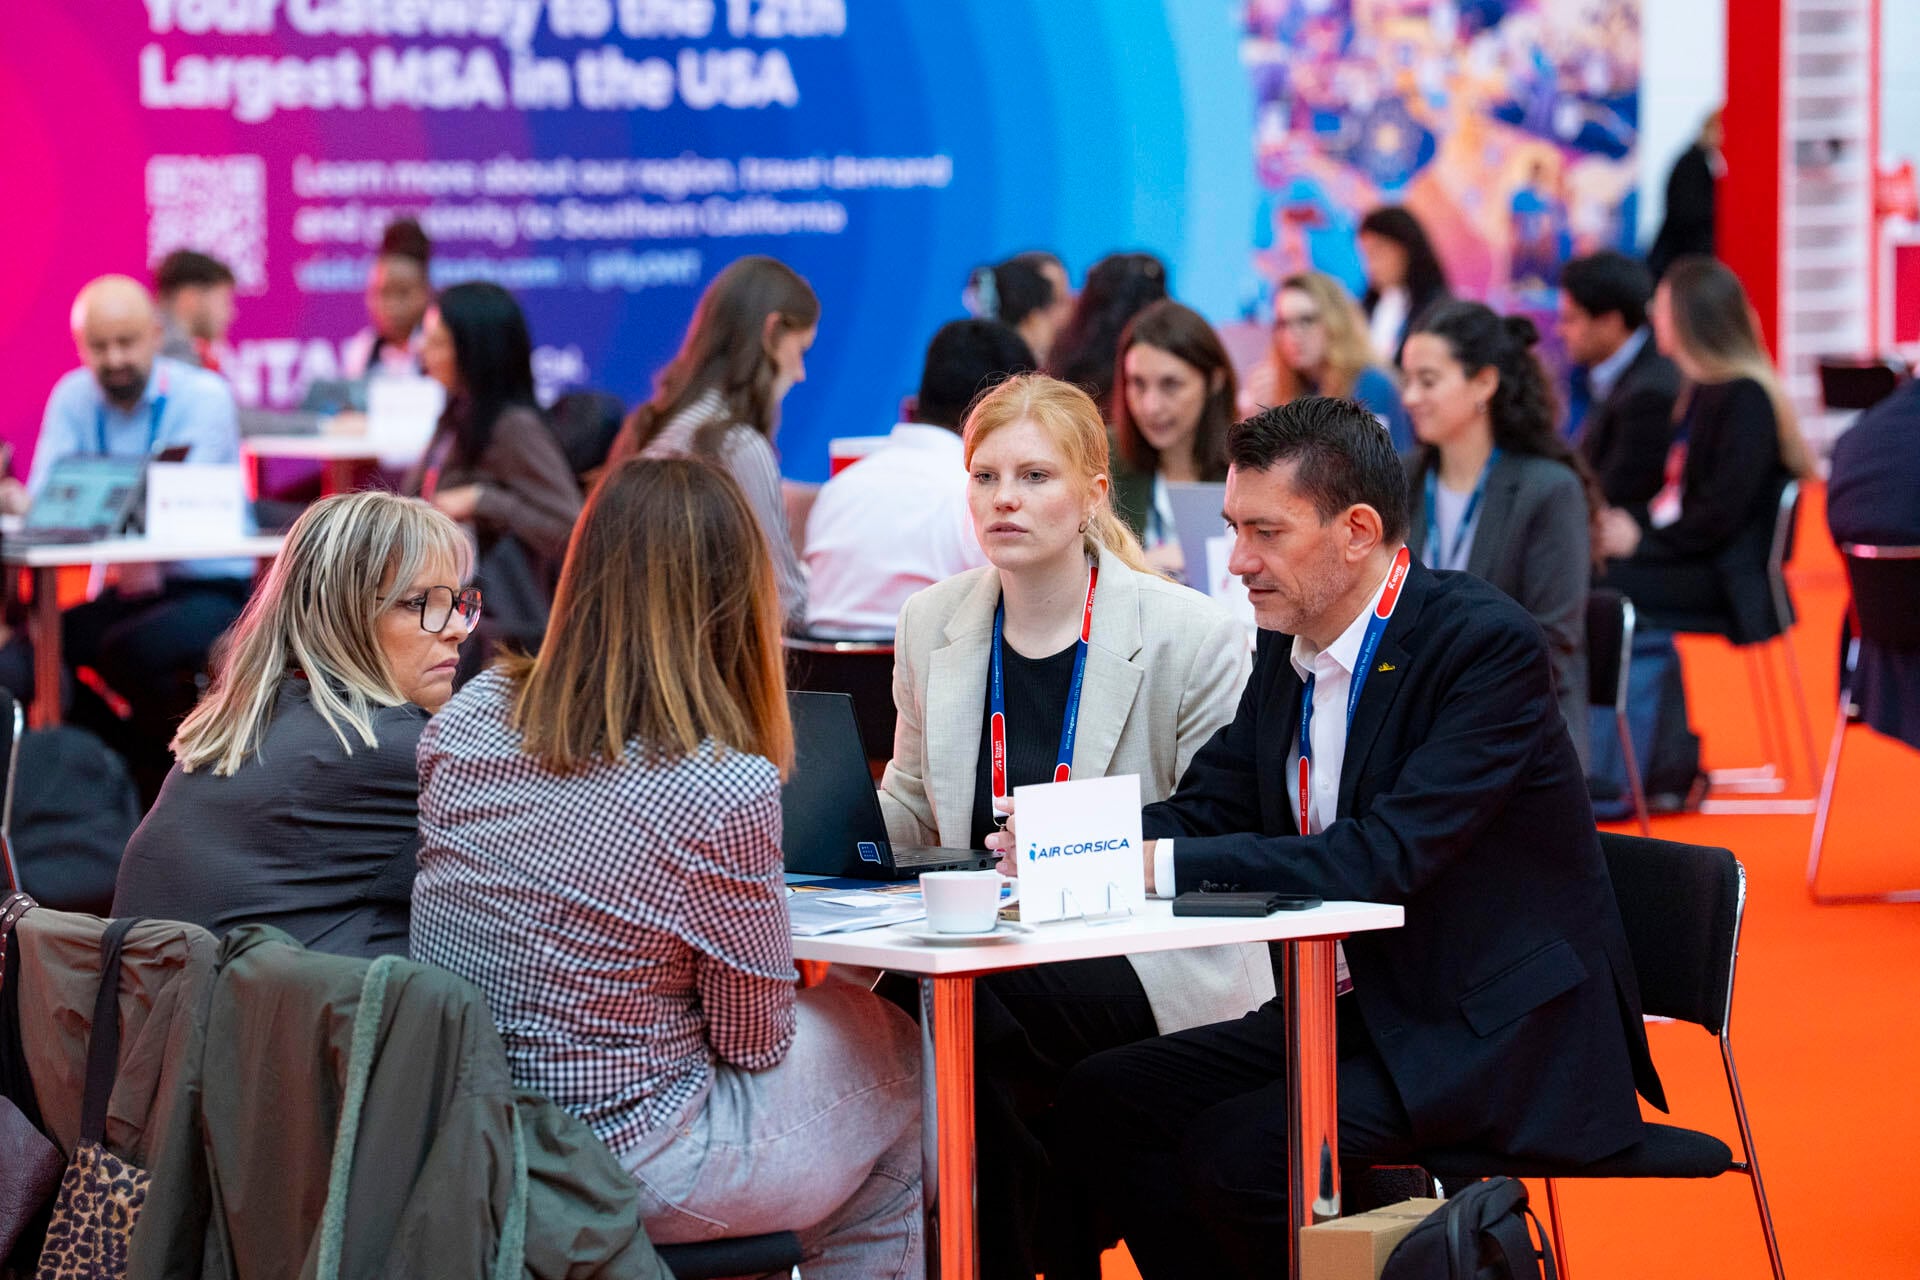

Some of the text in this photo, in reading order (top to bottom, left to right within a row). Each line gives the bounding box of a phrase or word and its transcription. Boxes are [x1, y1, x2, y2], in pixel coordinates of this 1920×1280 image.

[143, 0, 274, 35] Your
[286, 0, 546, 48] Gateway
[550, 0, 613, 38] to
[617, 0, 716, 38] the
[139, 43, 800, 122] Largest MSA in the USA
[292, 153, 386, 198] Learn
[389, 160, 475, 197] more
[484, 153, 575, 196] about
[832, 153, 953, 190] demand
[293, 201, 362, 243] and
[556, 197, 698, 240] Southern
[701, 196, 848, 237] California
[1037, 838, 1130, 859] AIR CORSICA
